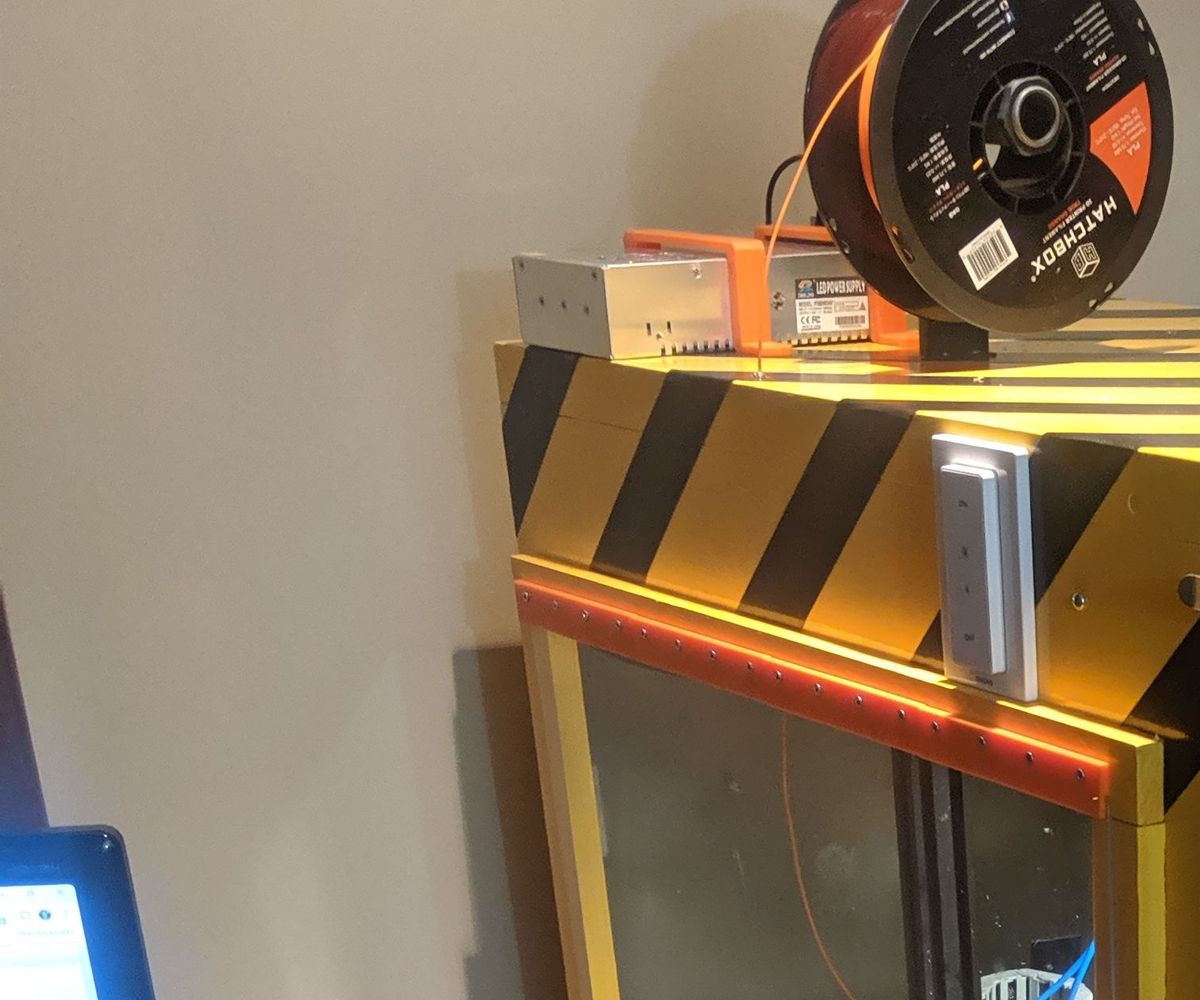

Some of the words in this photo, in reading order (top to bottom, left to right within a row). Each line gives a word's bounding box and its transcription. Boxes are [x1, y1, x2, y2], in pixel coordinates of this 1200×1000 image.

[935, 181, 950, 196] PLA
[1030, 195, 1117, 278] HATCHBOX
[816, 281, 826, 295] LED
[827, 281, 846, 295] POWER
[846, 280, 866, 293] SUPPLY
